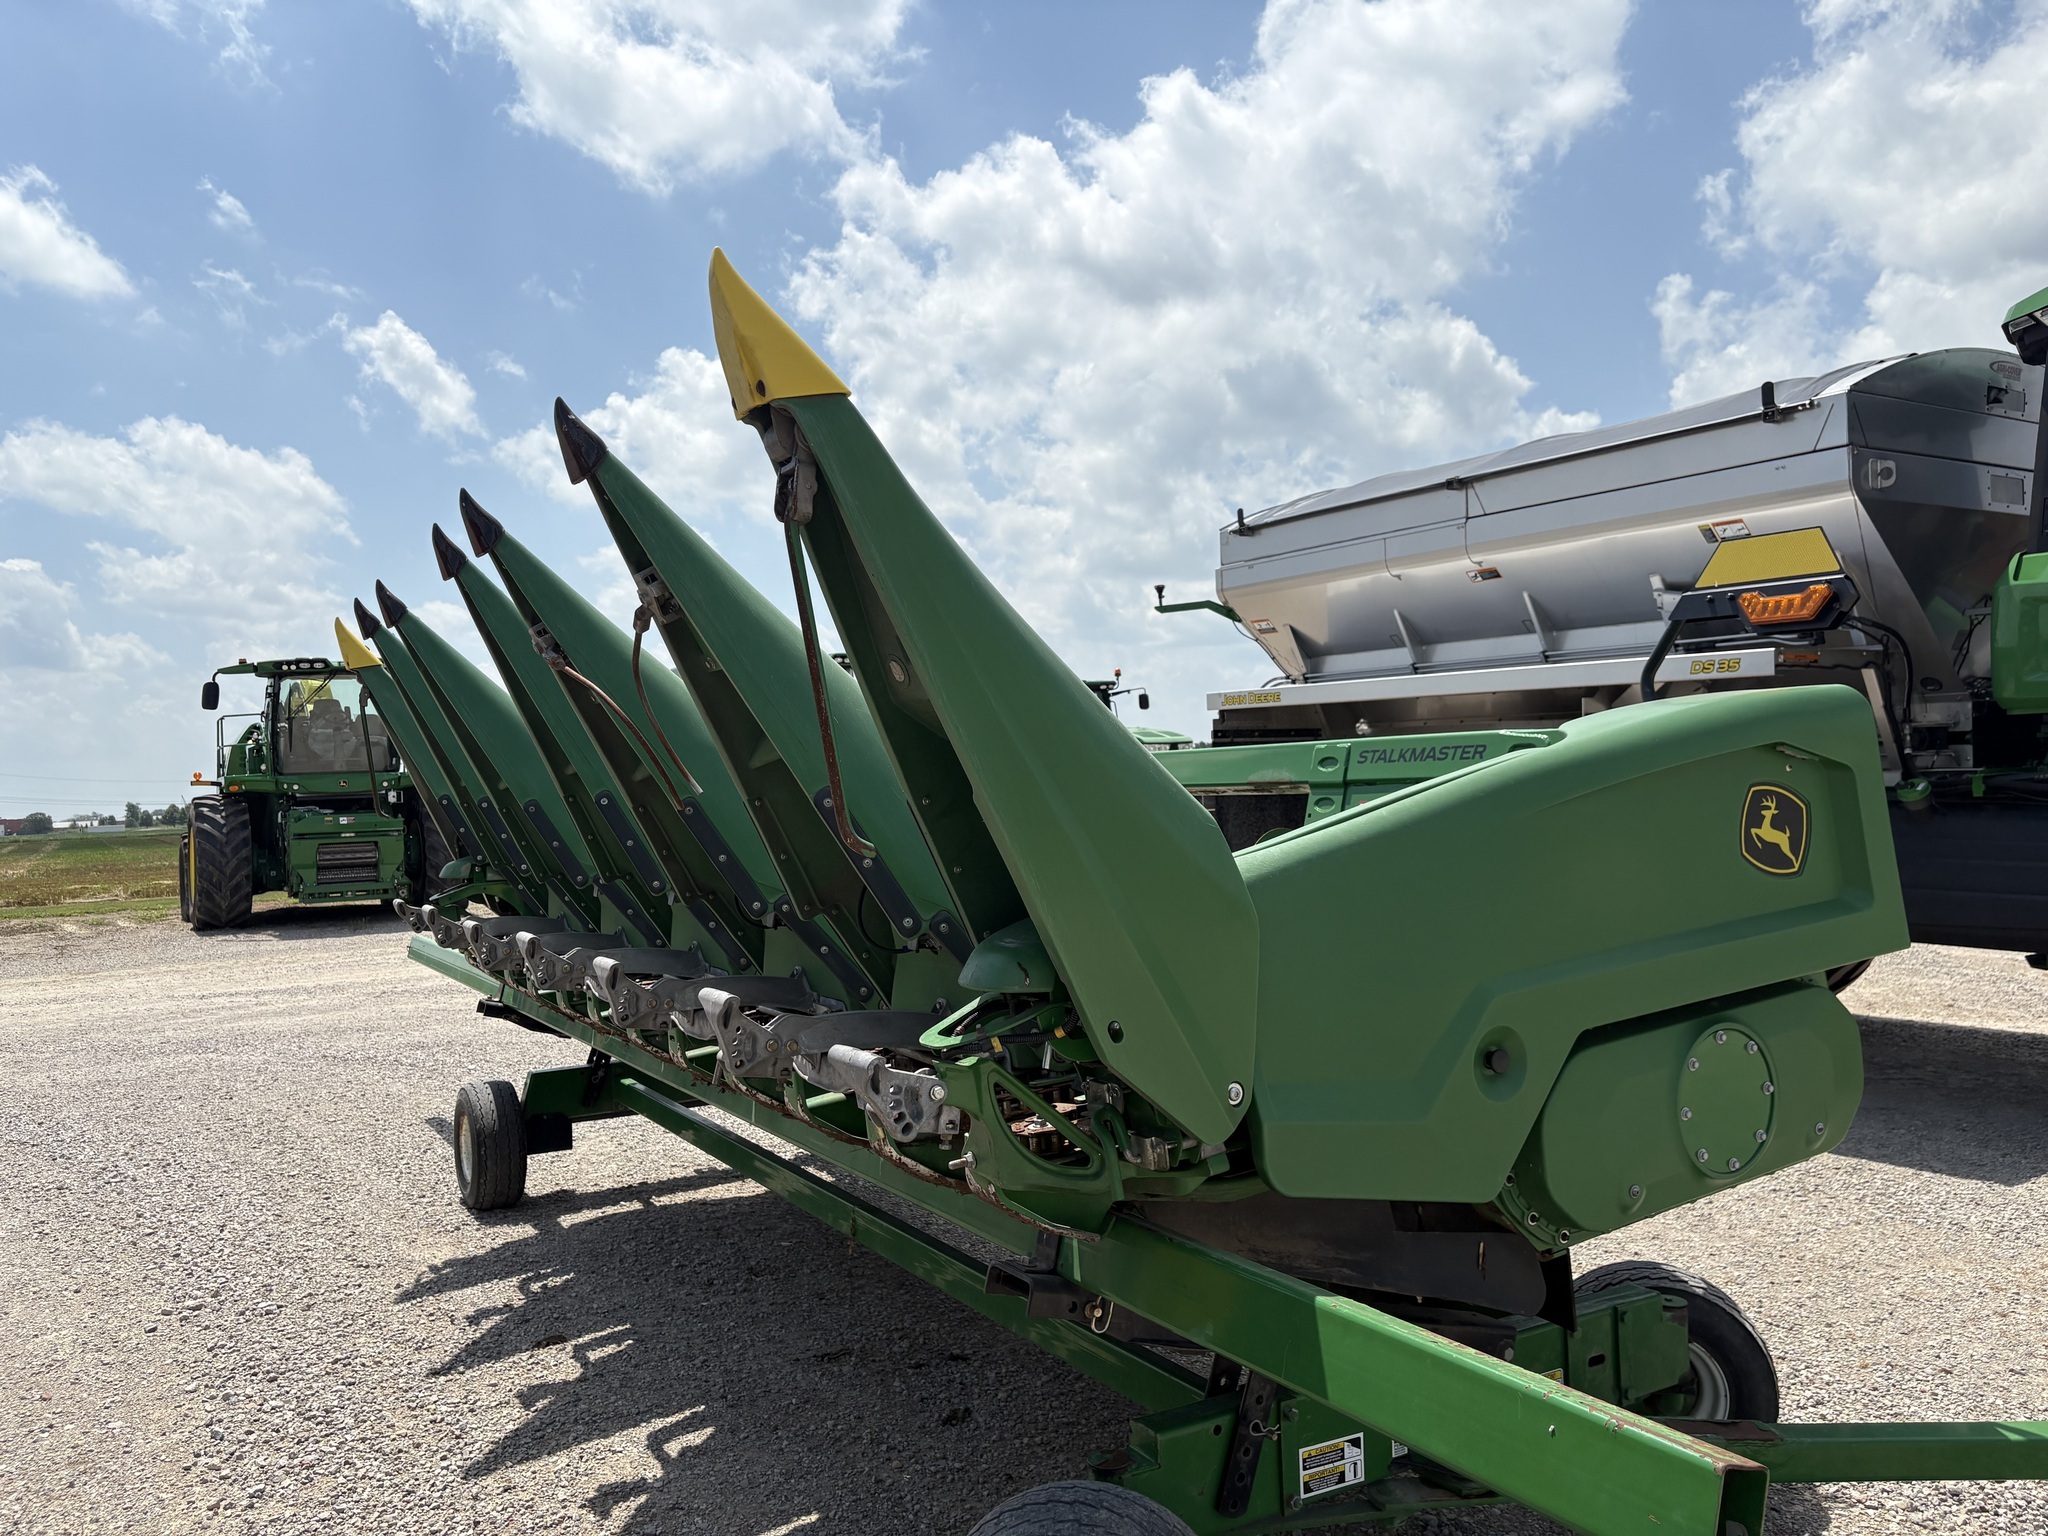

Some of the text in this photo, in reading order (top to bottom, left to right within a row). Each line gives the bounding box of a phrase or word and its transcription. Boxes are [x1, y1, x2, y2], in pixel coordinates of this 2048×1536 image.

[1690, 658, 1741, 674] DS 35
[1222, 692, 1281, 706] JOHN DEERE
[1357, 744, 1487, 764] STALKMASTER
